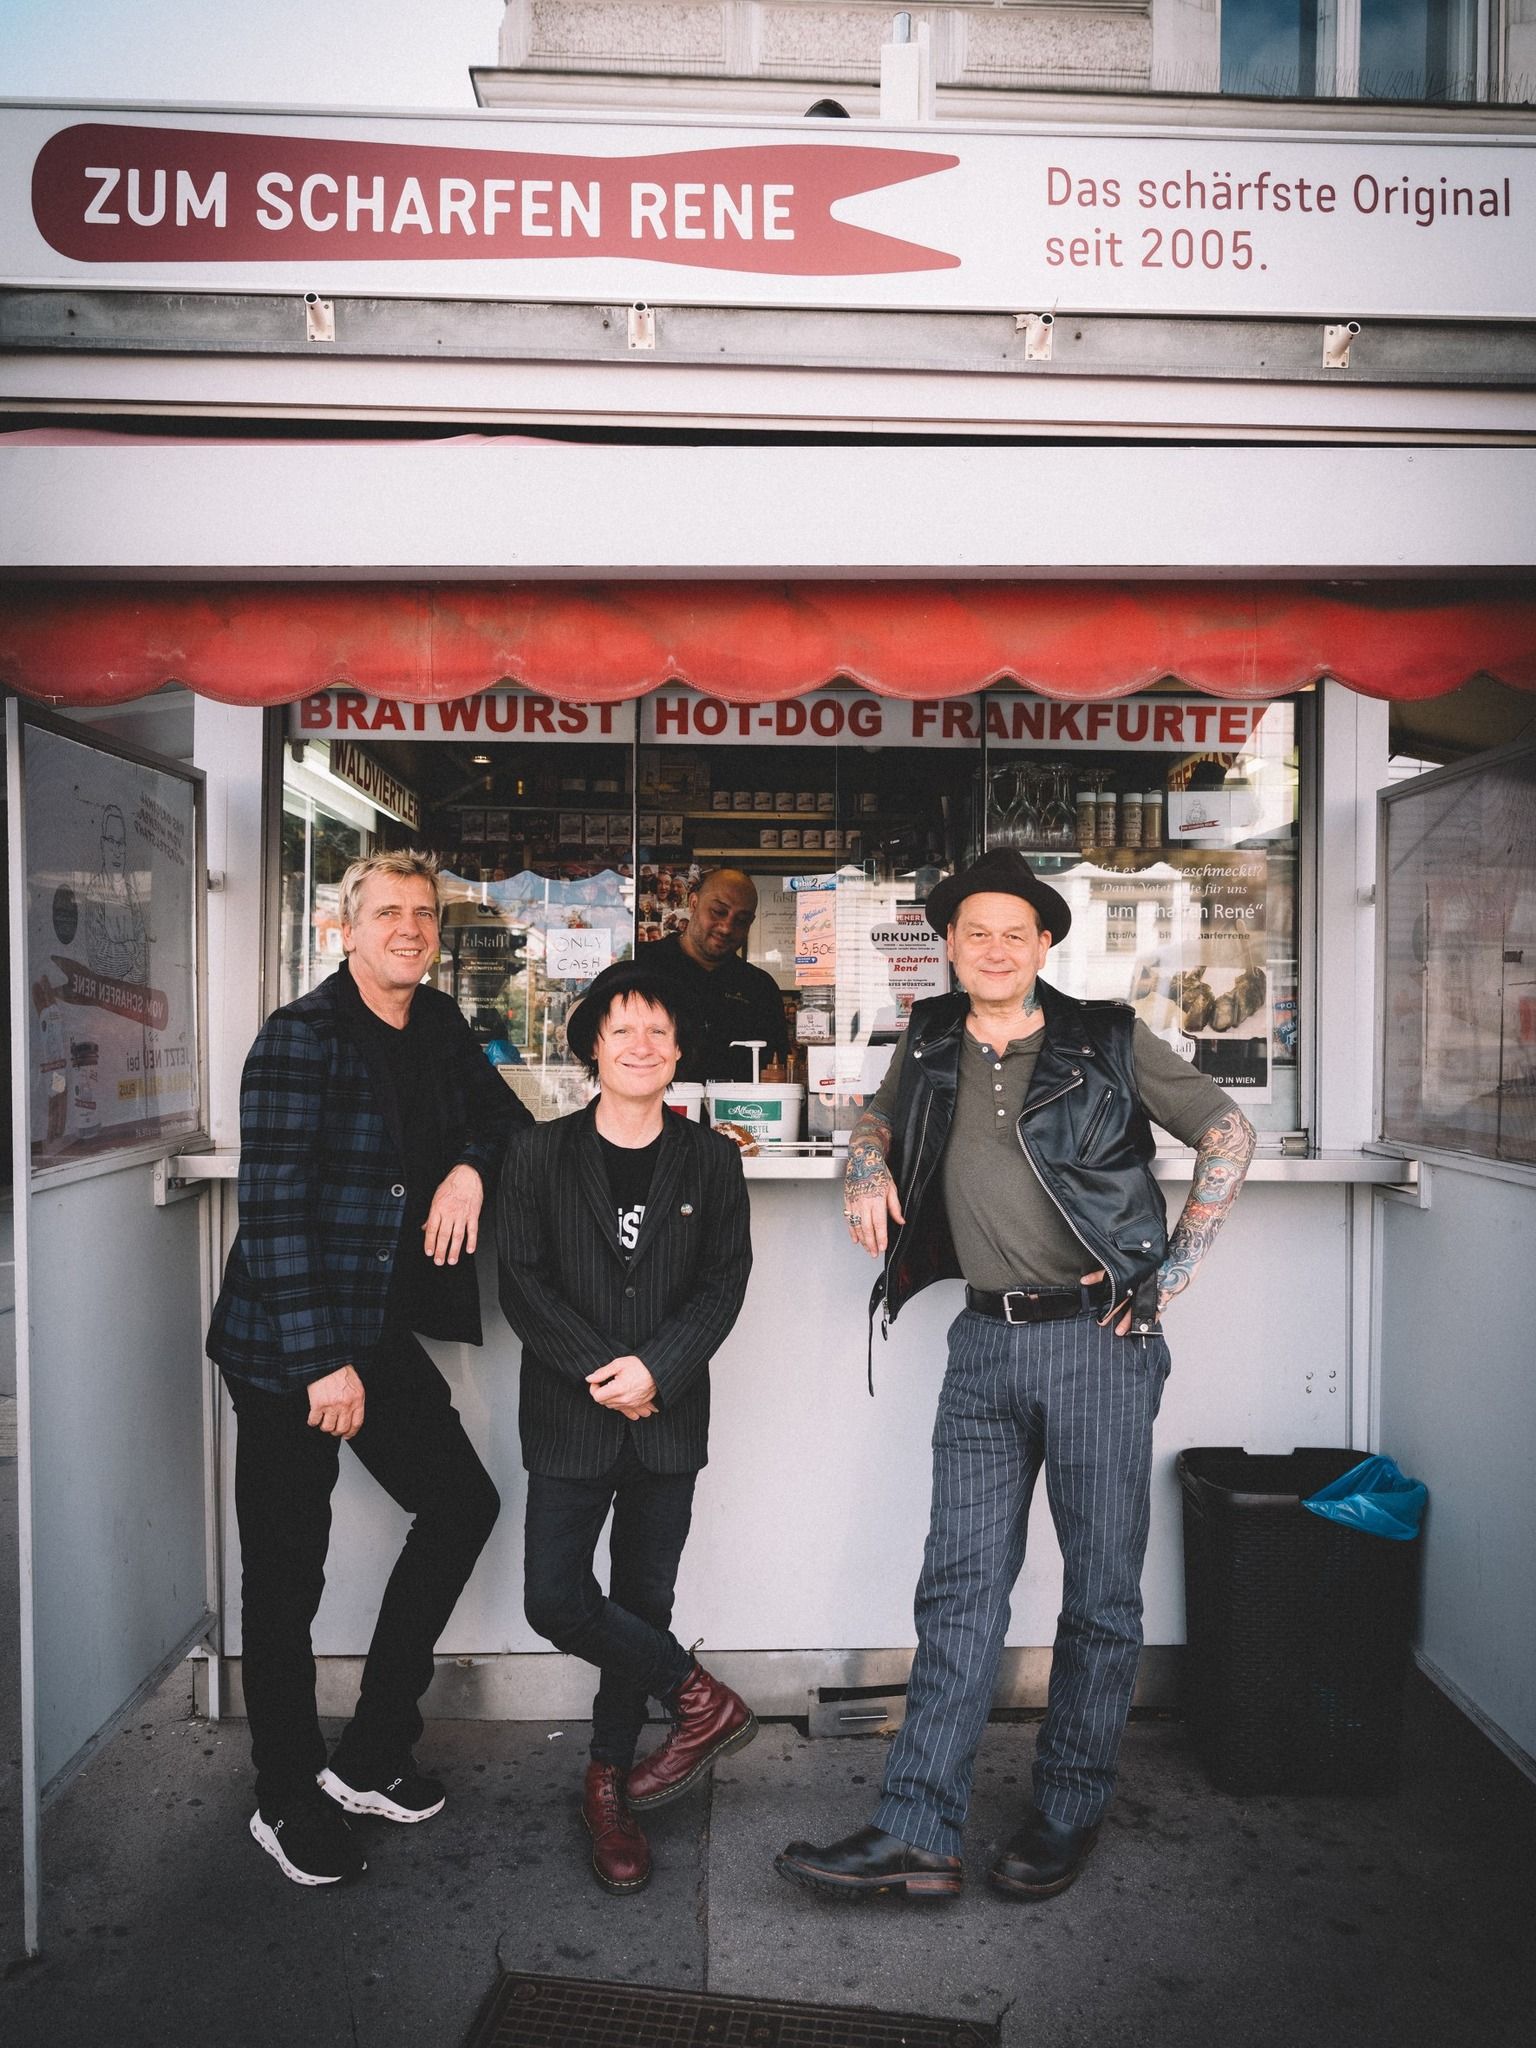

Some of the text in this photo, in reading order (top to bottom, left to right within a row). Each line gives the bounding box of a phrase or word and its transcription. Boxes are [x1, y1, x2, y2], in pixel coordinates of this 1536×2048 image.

[1047, 166, 1512, 227] Das schärfste Original
[82, 167, 796, 243] ZUM SCHARFEN RENE
[1045, 228, 1268, 272] seit 2005.
[300, 693, 622, 735] BRATWURST
[655, 697, 882, 737] HOT-DOG
[334, 741, 421, 825] WALDVIERTLER
[1204, 883, 1223, 897] für
[1226, 885, 1248, 895] uns
[461, 933, 509, 948] falstaff
[555, 936, 608, 953] ONLY
[871, 932, 940, 942] URKUNDE
[557, 956, 601, 971] CASH
[893, 963, 918, 973] René
[895, 956, 940, 964] scharfen
[1225, 1076, 1234, 1084] IN
[1235, 1076, 1256, 1084] WIEN
